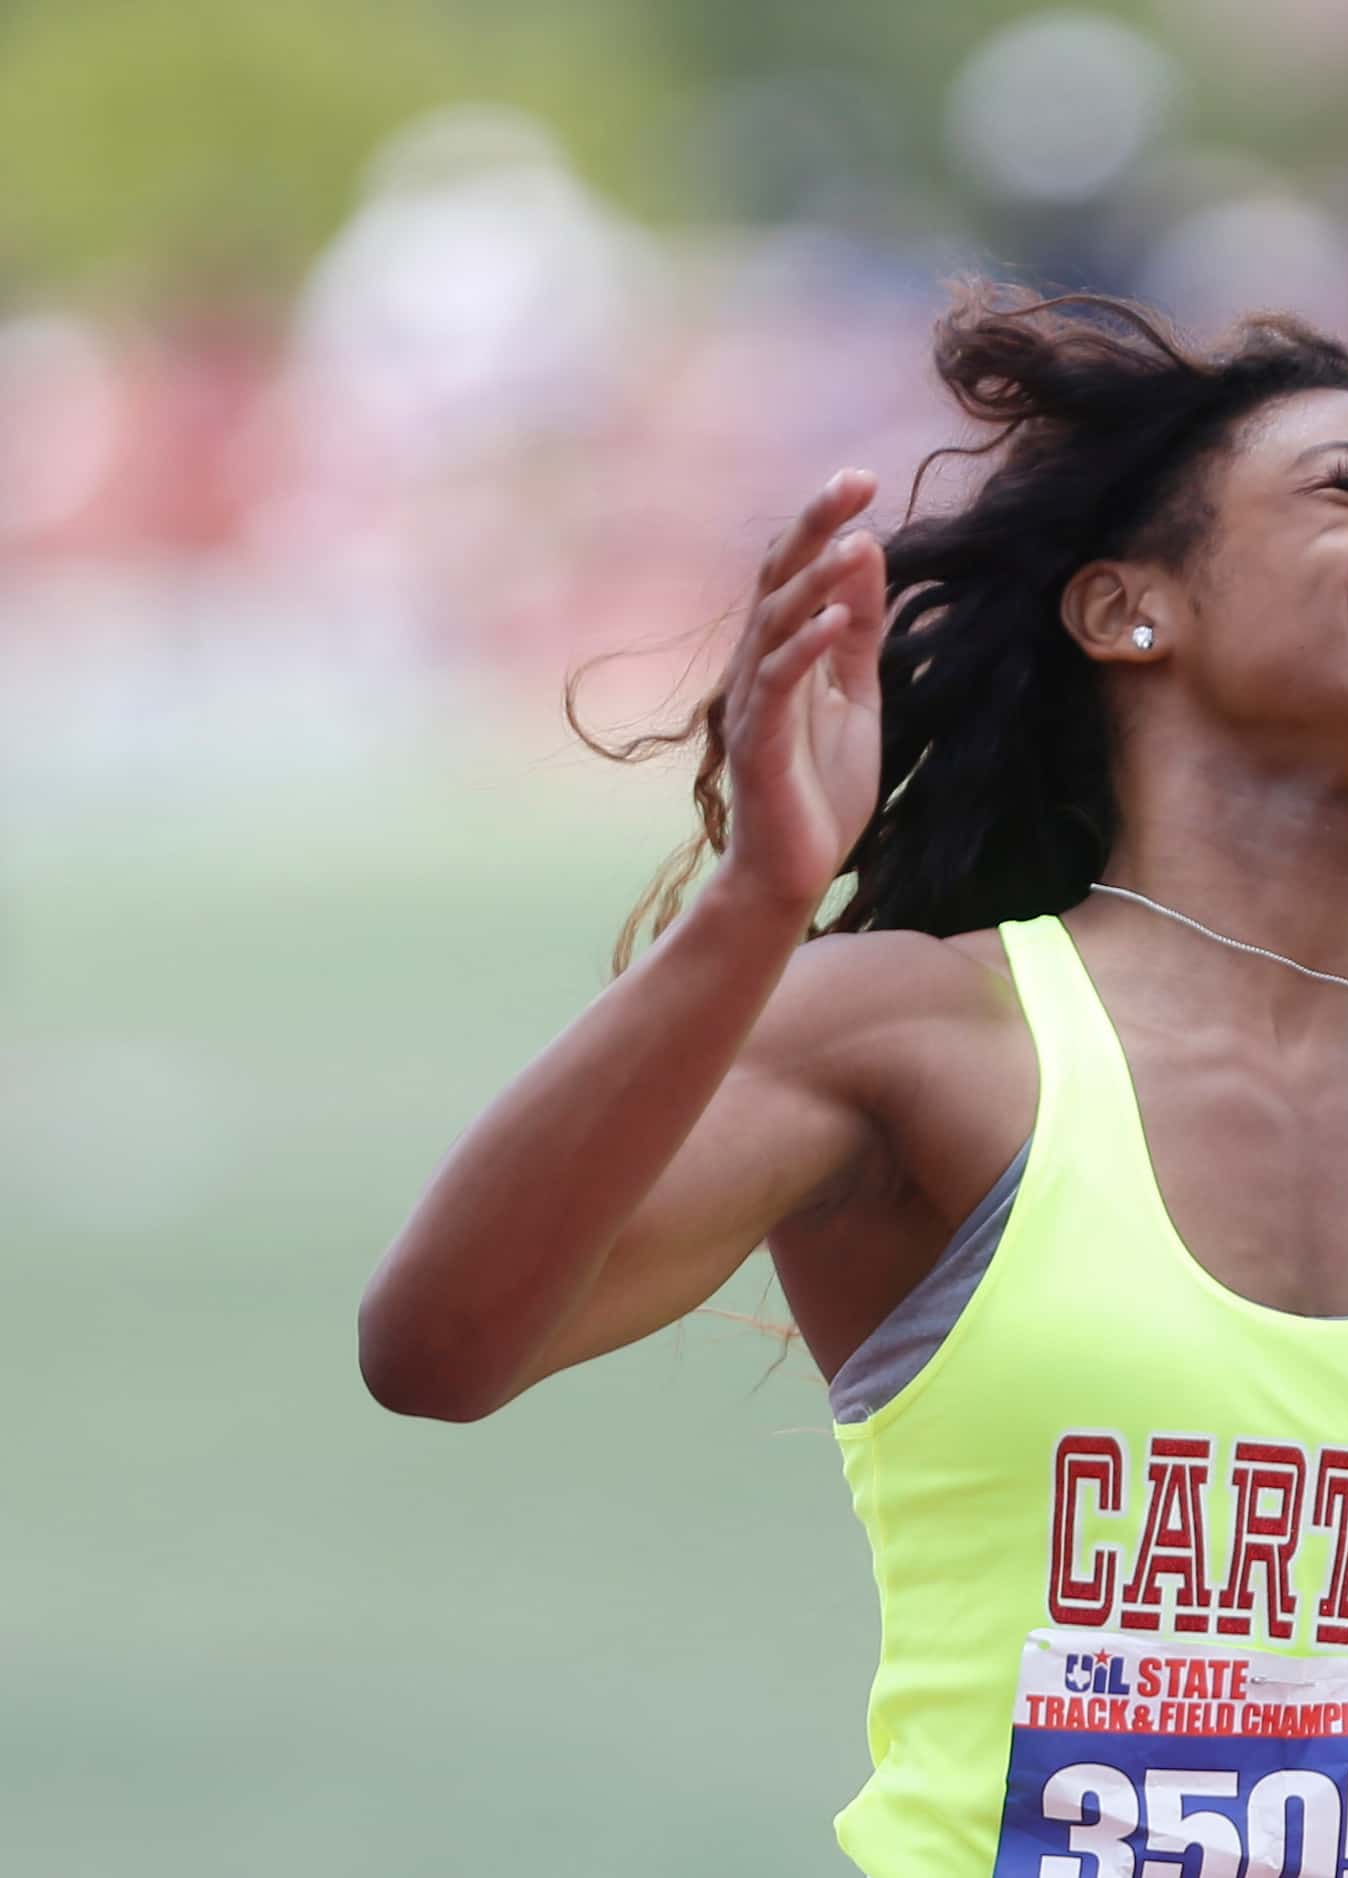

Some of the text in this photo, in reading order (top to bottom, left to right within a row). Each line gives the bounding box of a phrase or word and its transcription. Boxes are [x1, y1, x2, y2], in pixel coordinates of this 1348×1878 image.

[1137, 1656, 1250, 1700] STATE
[1026, 1694, 1131, 1731] TRACK
[1158, 1701, 1236, 1735] FIELD
